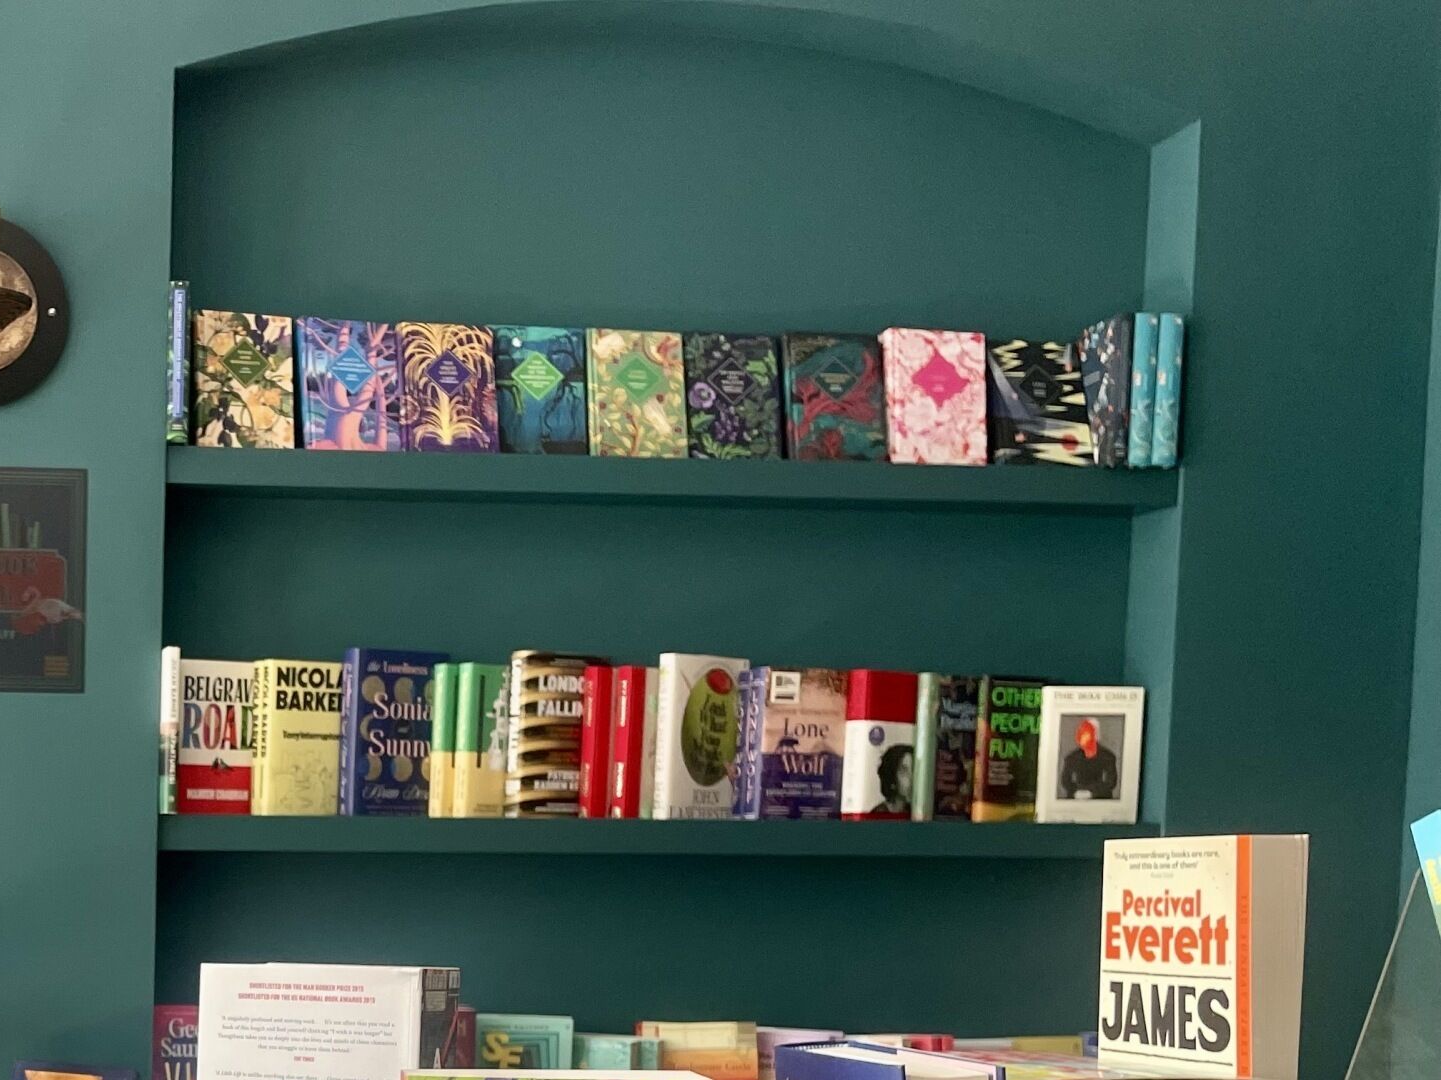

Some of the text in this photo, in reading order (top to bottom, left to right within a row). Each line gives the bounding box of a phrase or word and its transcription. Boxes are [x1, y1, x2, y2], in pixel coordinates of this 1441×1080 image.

[183, 675, 256, 703] BELGRAV
[372, 691, 433, 721] Sonia
[182, 702, 256, 750] ROAD
[783, 717, 830, 740] Lone
[782, 752, 829, 776] Wolf
[989, 738, 1024, 760] FUN
[1122, 888, 1202, 918] Percival
[1105, 911, 1229, 966] Everett
[1101, 981, 1232, 1053] JAMES
